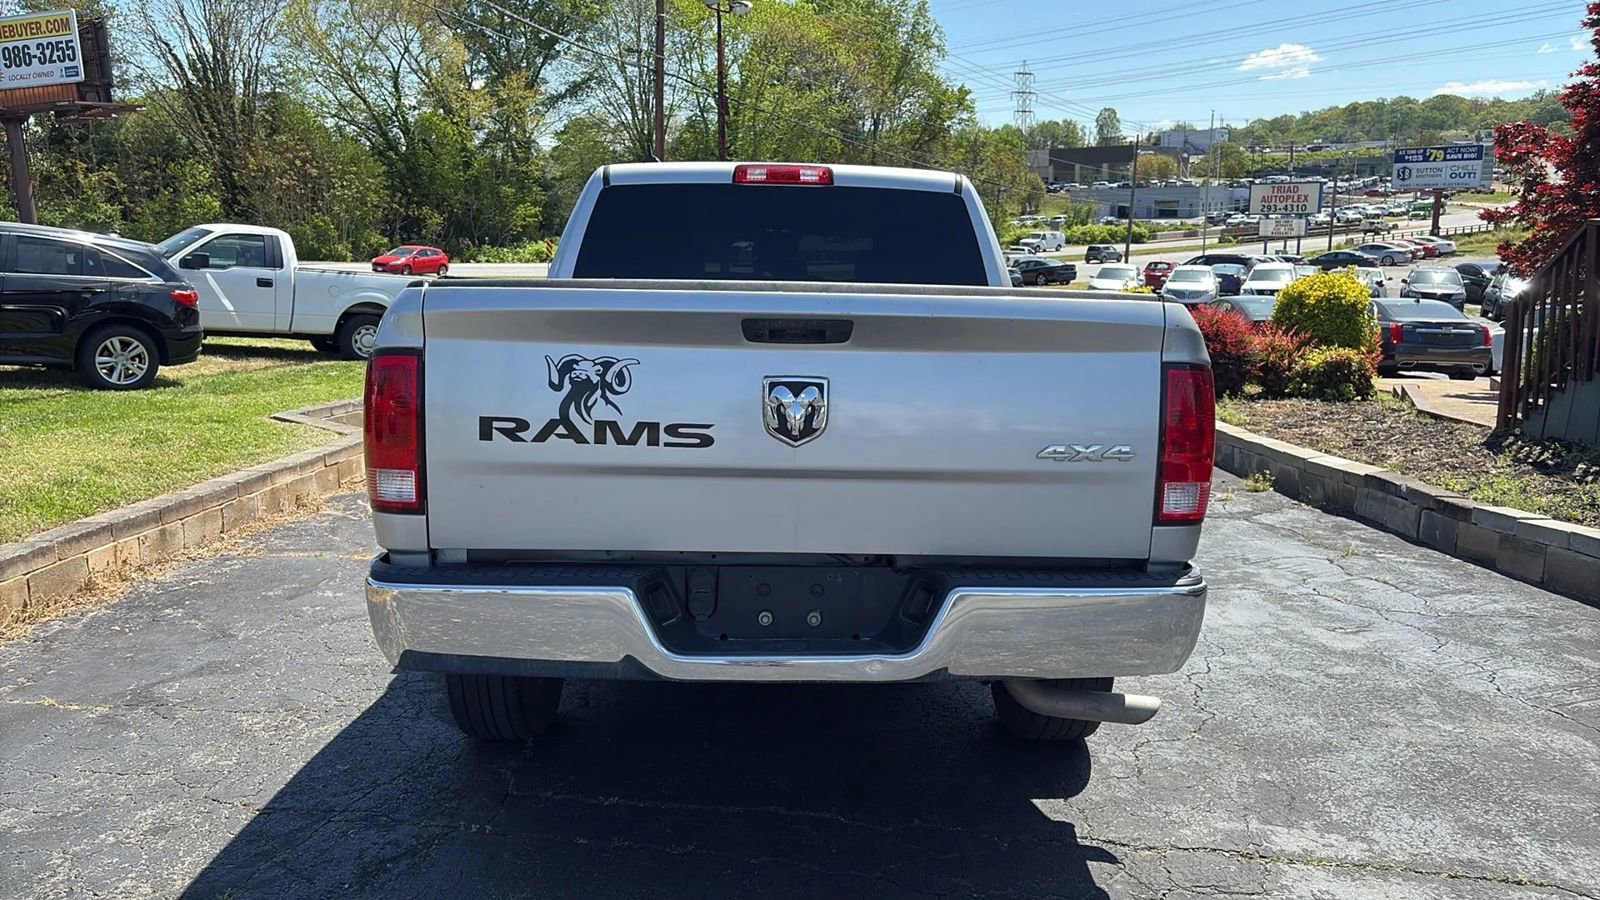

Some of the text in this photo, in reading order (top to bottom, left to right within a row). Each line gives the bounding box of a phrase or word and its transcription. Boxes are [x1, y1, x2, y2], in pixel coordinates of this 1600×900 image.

[0, 17, 71, 39] EBUYER.COM
[2, 39, 77, 69] 986-3255
[8, 73, 31, 82] LOCALLY
[32, 70, 55, 79] OWNED
[1426, 148, 1445, 161] $79
[1450, 164, 1477, 172] CHILL
[1449, 171, 1477, 180] OUT!
[1271, 185, 1300, 194] TRIAD
[1260, 194, 1309, 203] AUTOPLEX
[1260, 204, 1307, 212] 293-4310
[478, 415, 716, 449] RAMS
